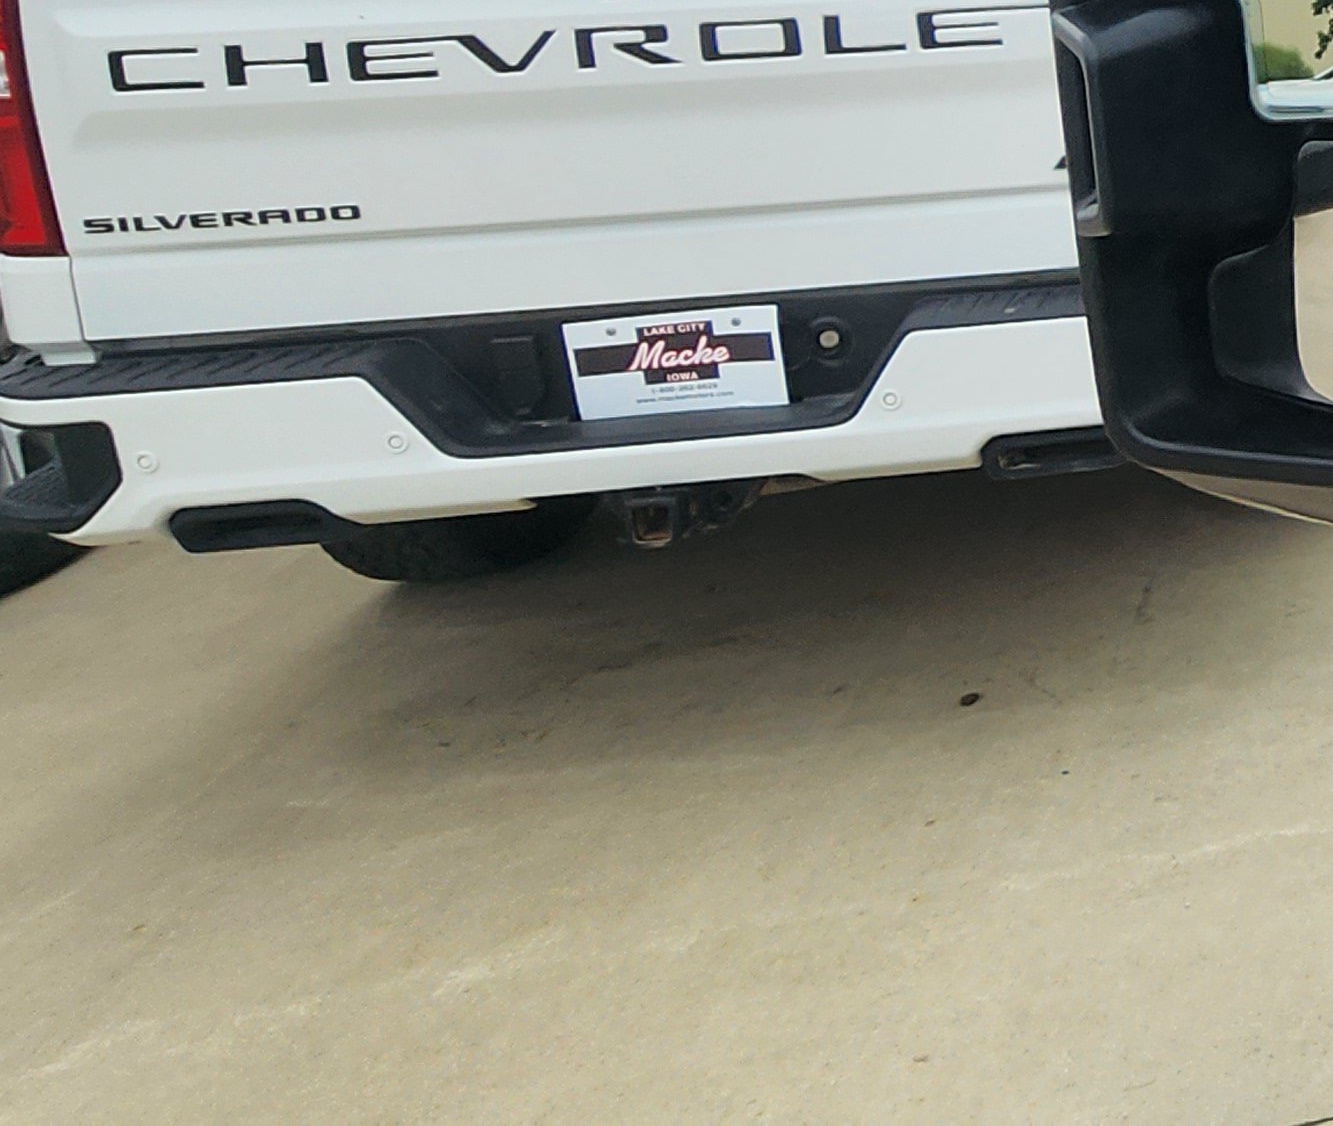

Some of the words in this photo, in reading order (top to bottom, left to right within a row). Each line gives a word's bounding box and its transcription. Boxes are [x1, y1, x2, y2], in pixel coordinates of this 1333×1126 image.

[108, 4, 1050, 92] CHEVROLE
[83, 204, 361, 234] SILVERADO
[643, 325, 675, 336] LAKE
[677, 322, 706, 333] CITY
[627, 335, 731, 370] Macke
[666, 371, 699, 382] IOWA
